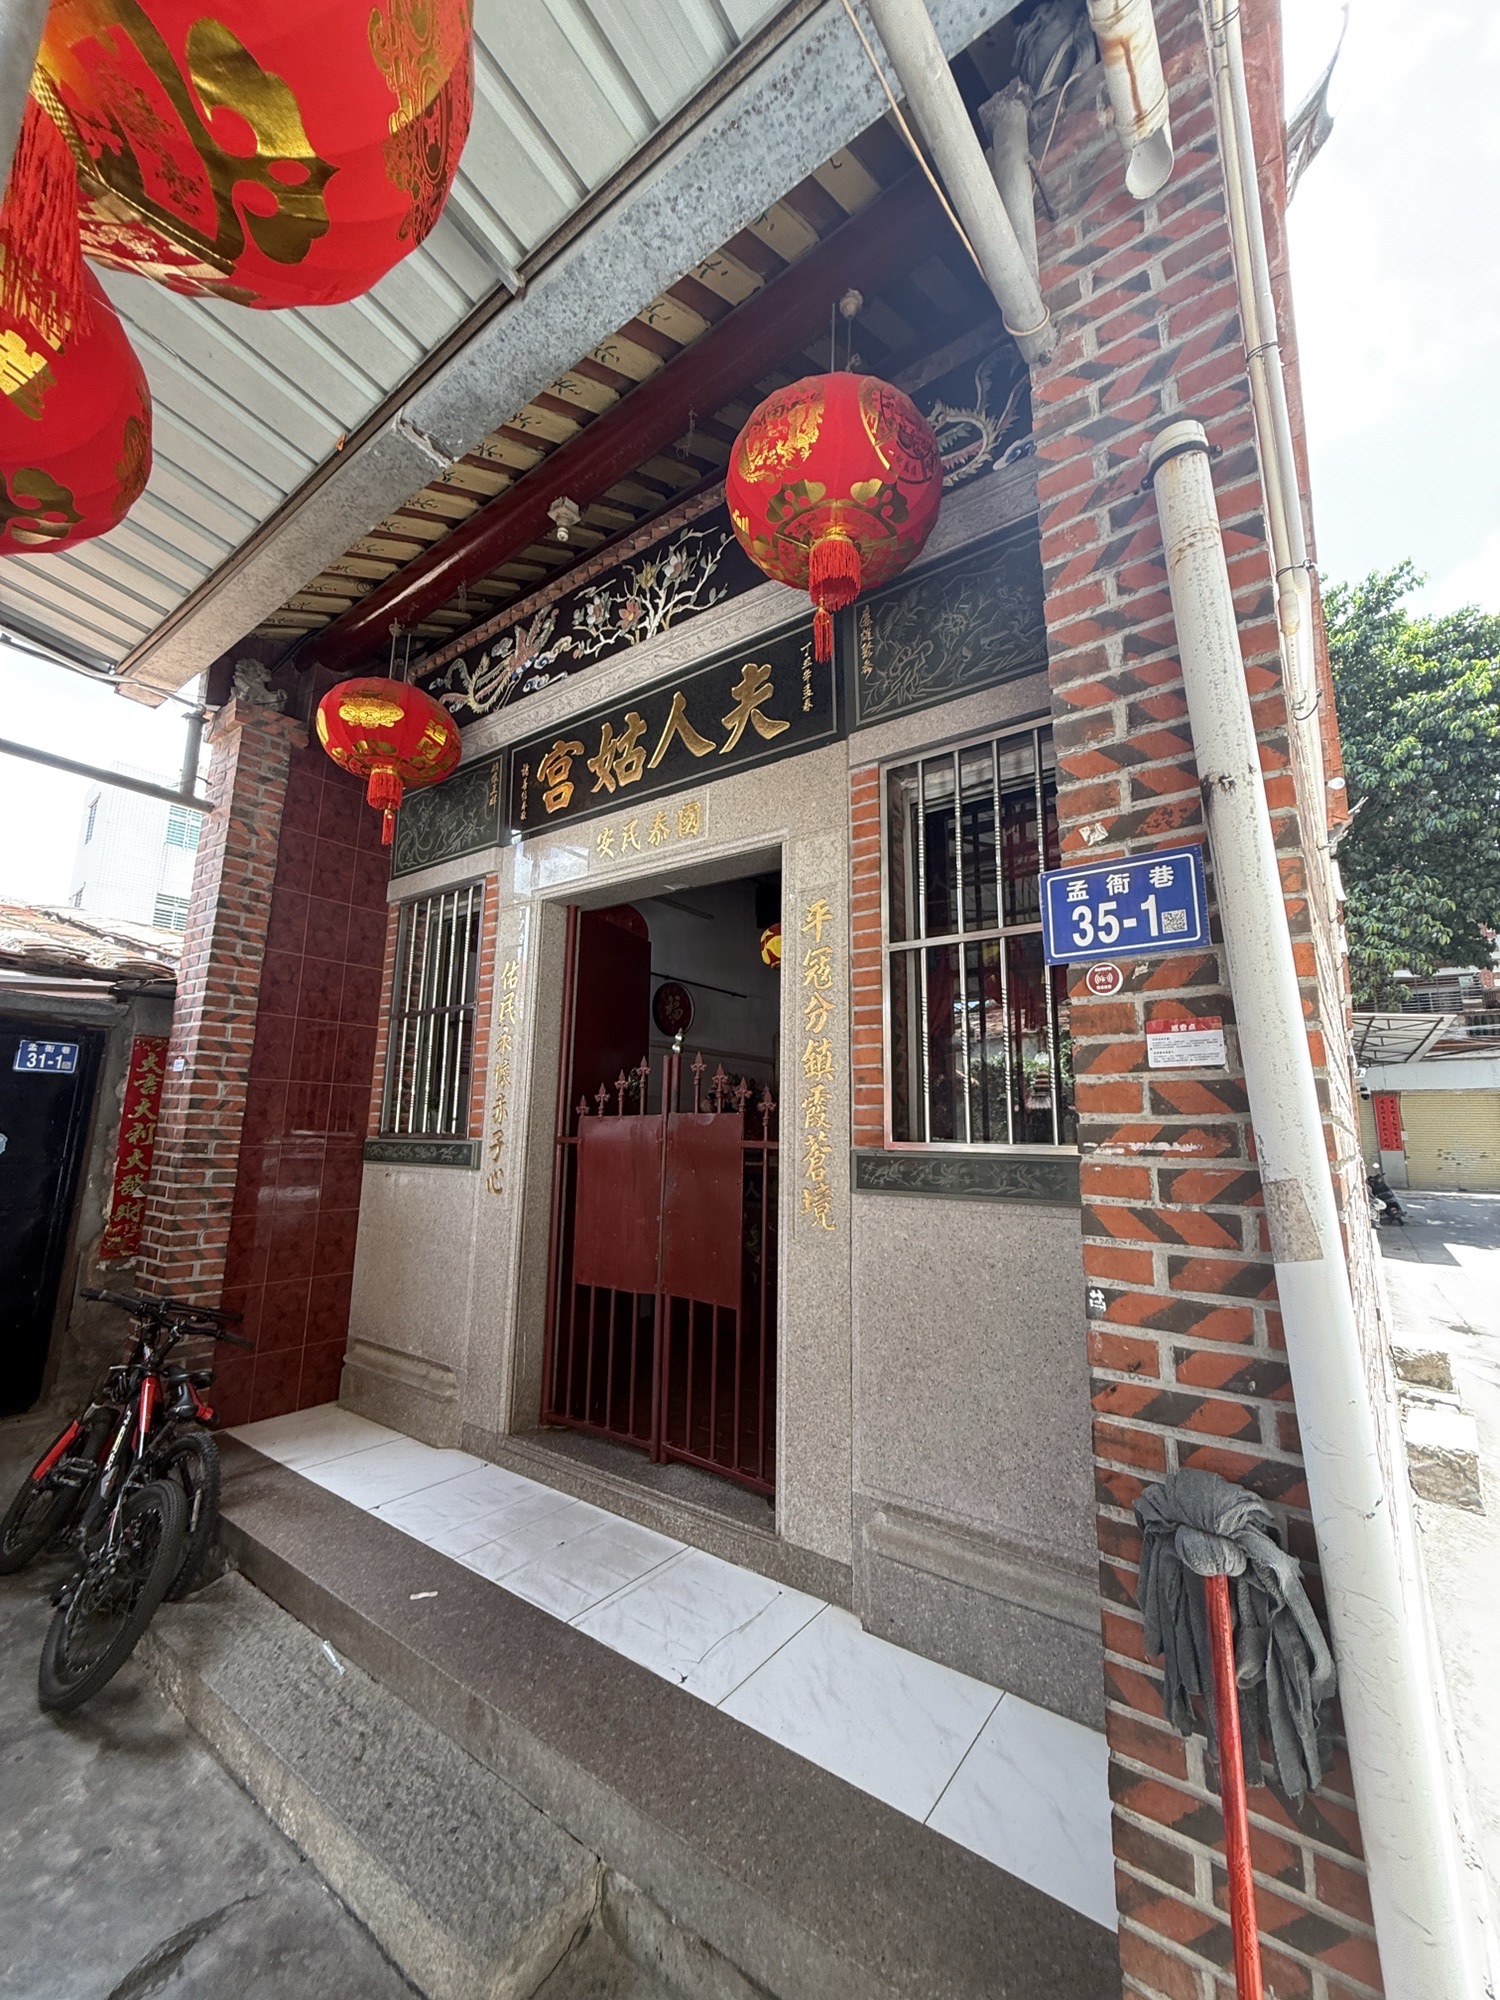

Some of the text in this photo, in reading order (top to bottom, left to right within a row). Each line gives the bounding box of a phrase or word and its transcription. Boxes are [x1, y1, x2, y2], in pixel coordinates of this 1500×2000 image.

[596, 801, 702, 859] 國泰民安
[1066, 864, 1175, 903] 孟衙巷
[1071, 894, 1160, 948] 35-1
[26, 1052, 63, 1070] 31-1
